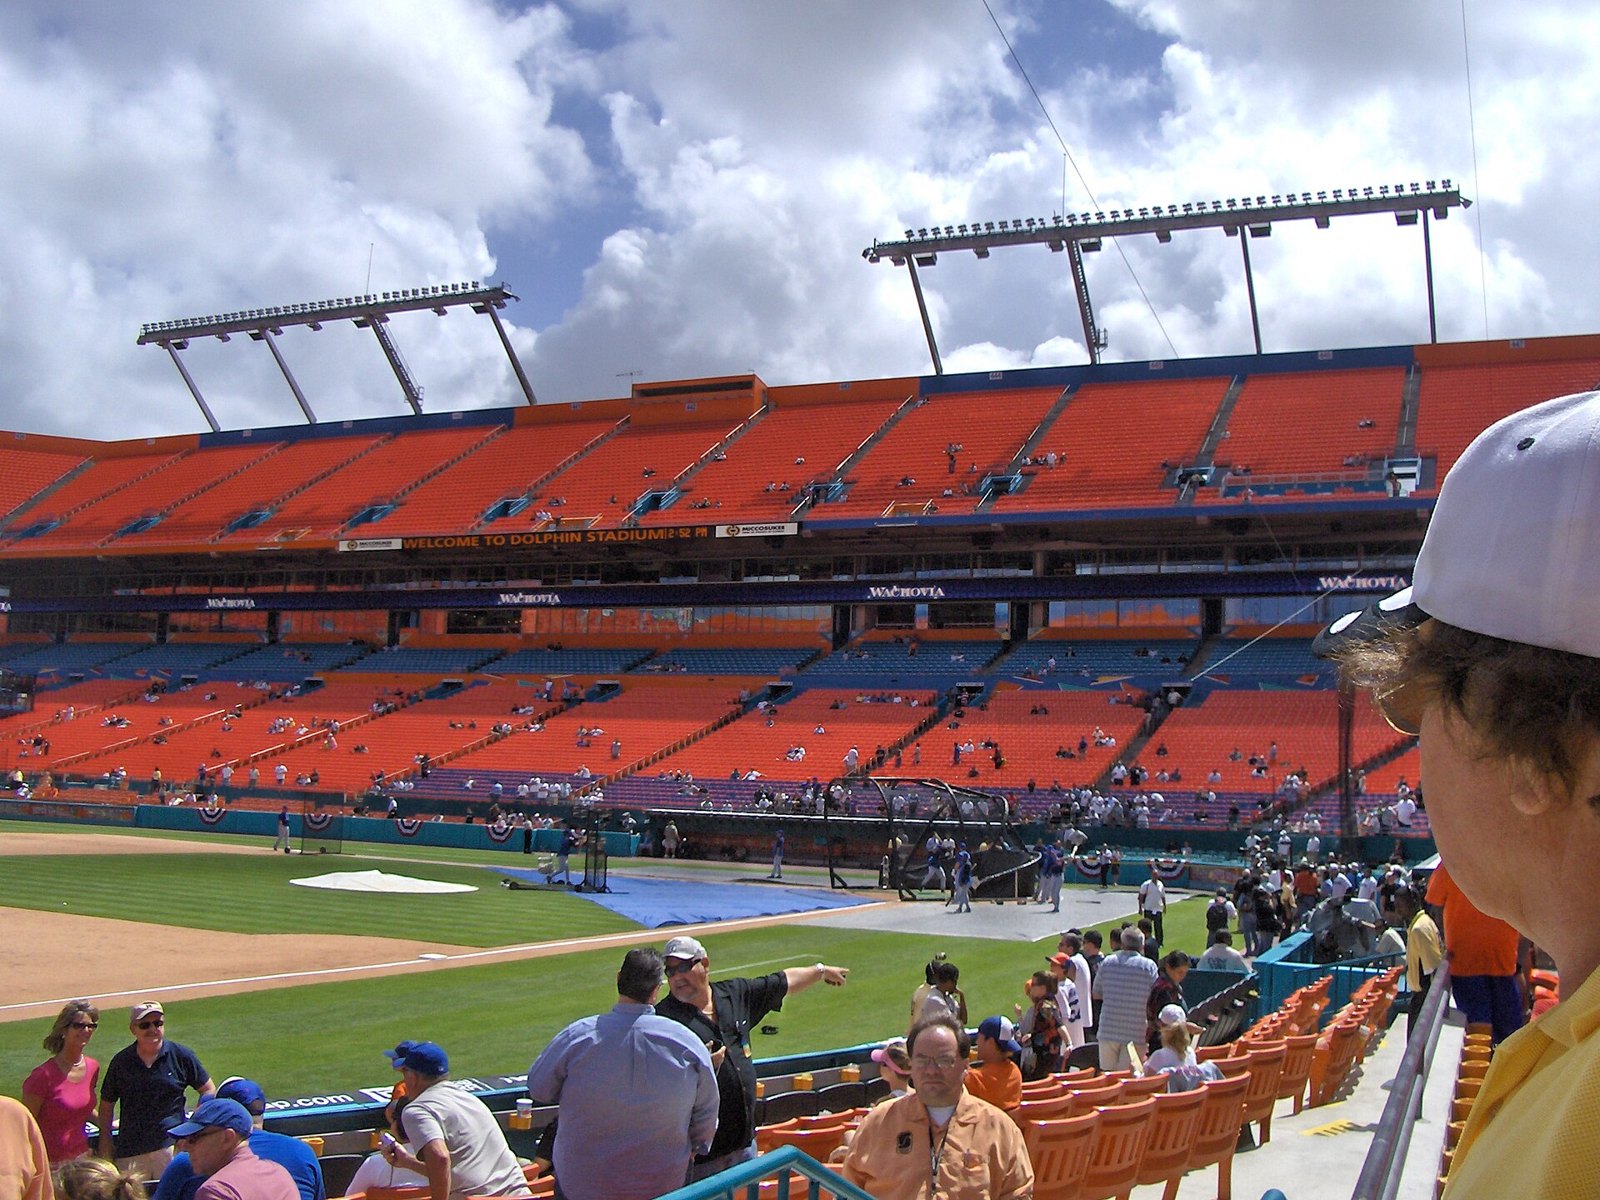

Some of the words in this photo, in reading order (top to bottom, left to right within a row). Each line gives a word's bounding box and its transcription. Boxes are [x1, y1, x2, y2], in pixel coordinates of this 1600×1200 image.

[404, 537, 480, 549] WELCOME
[486, 535, 505, 545] TO
[510, 532, 581, 545] DOLPHIN
[587, 529, 665, 542] STADIUM
[1317, 575, 1408, 590] WACHOVIA
[499, 592, 561, 605] WACHOVIA
[868, 586, 945, 599] WACHOVIA
[207, 597, 256, 609] WACHOVIA
